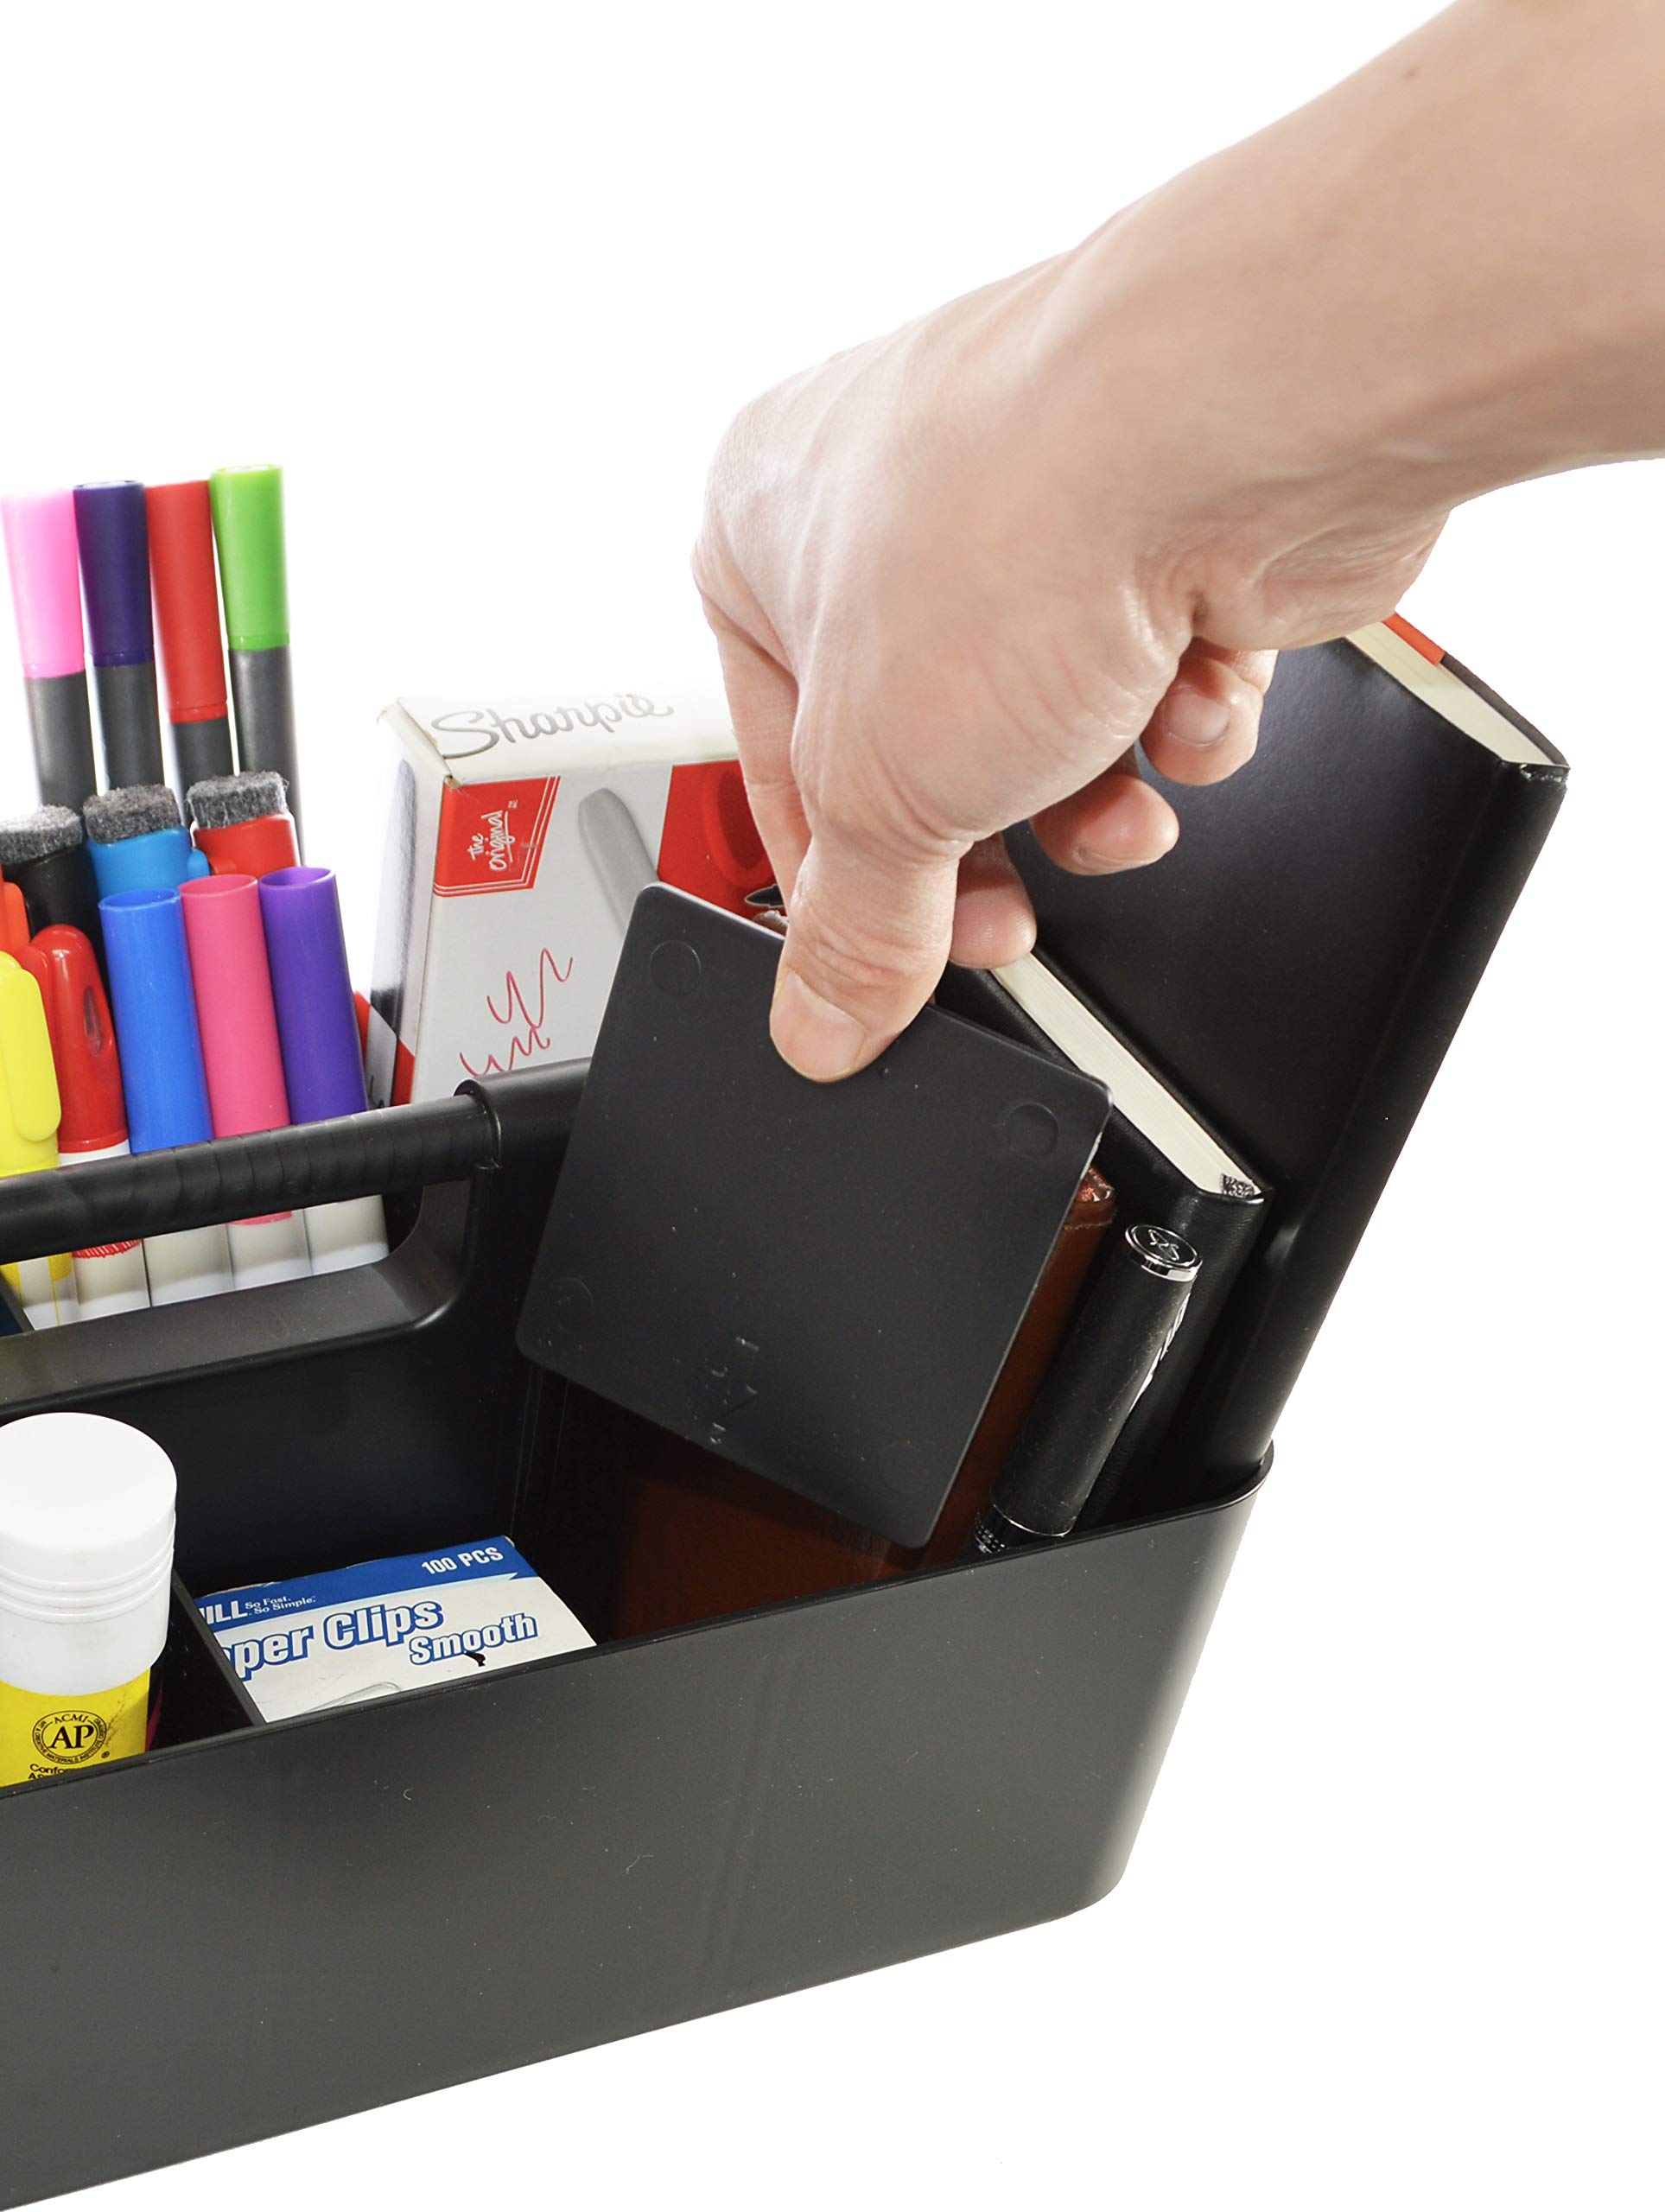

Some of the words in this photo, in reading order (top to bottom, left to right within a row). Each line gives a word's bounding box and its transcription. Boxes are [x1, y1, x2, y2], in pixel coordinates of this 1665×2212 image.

[431, 694, 674, 759] Sharpie
[422, 1557, 458, 1574] 100
[457, 1547, 504, 1567] PCS
[199, 1600, 248, 1625] ILL
[245, 1601, 262, 1610] So
[263, 1596, 291, 1606] Fast.
[254, 1606, 270, 1615] So
[223, 1625, 315, 1681] per
[323, 1600, 444, 1648] Clips
[409, 1612, 539, 1666] Smooth
[54, 1713, 89, 1725] ACMI
[47, 1724, 94, 1750] AP
[29, 1764, 66, 1776] Confo
